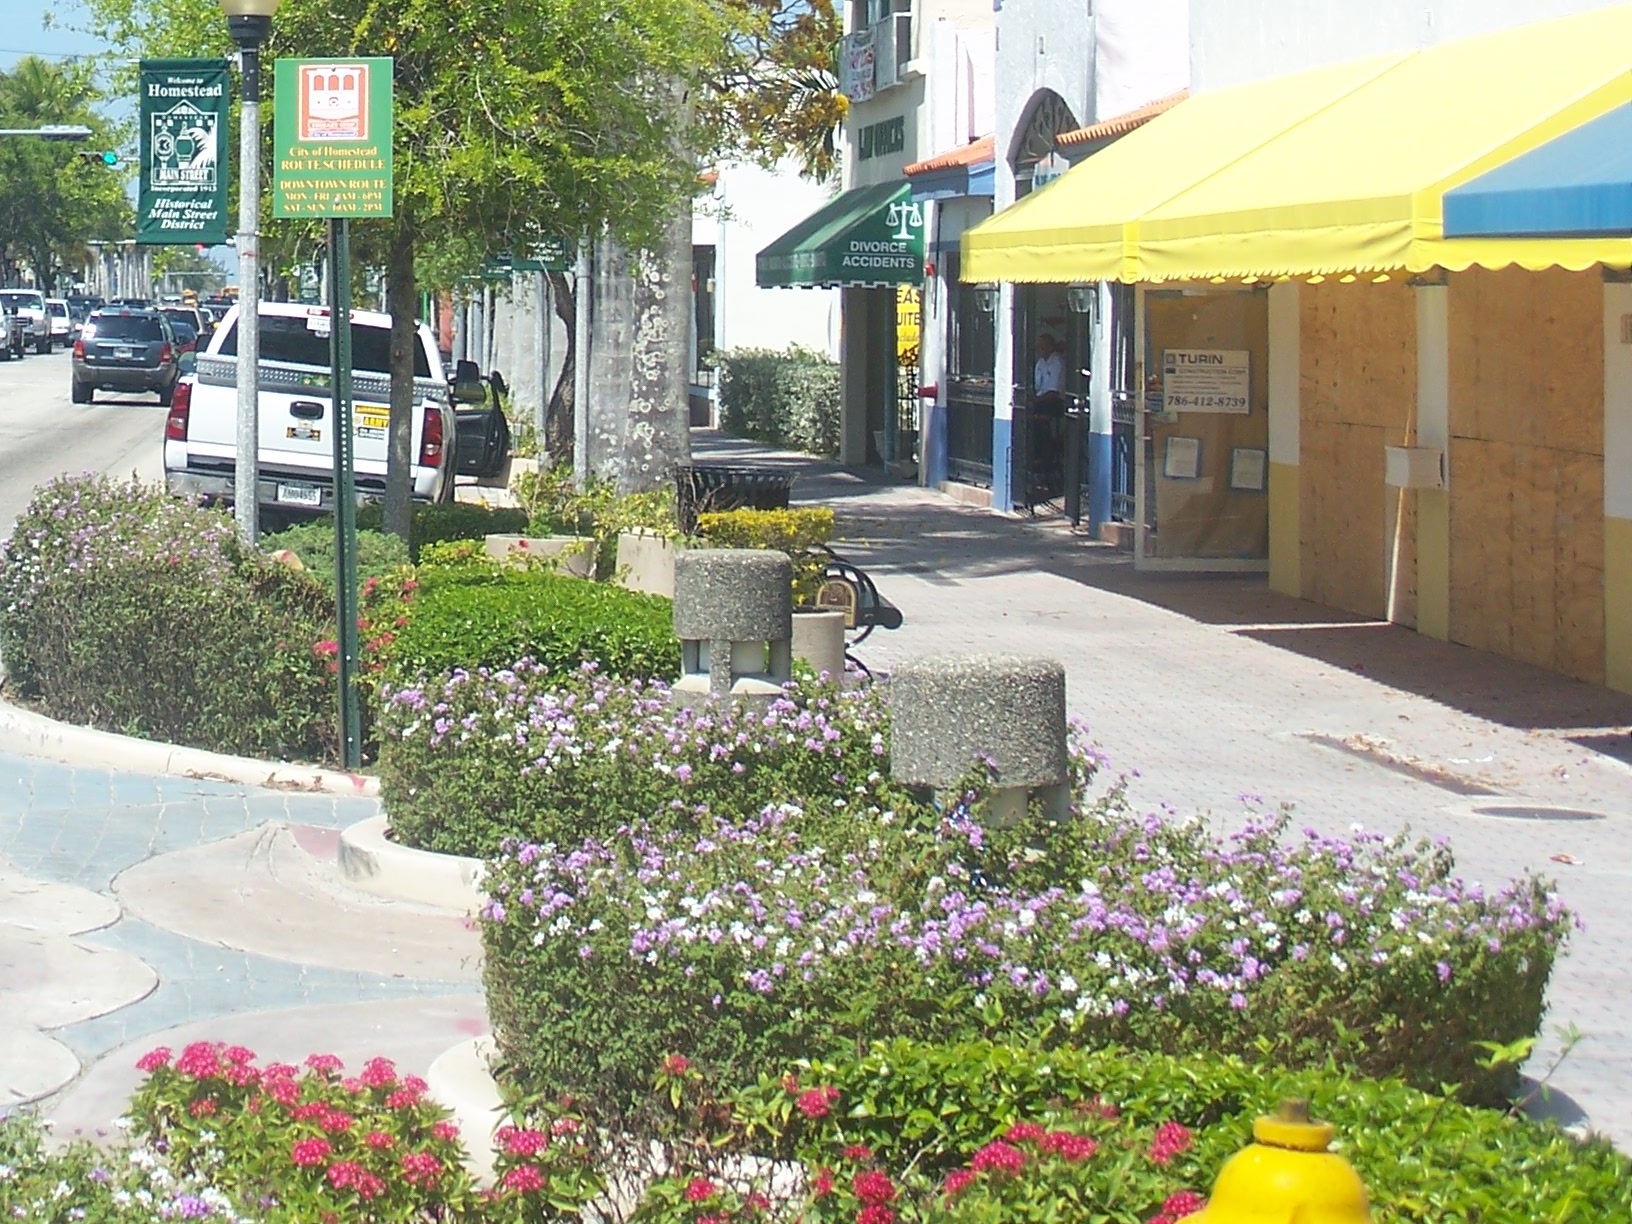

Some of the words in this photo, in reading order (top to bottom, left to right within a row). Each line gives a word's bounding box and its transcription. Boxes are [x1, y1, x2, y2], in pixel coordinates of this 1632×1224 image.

[148, 83, 223, 97] Homestead
[289, 147, 309, 159] City
[312, 146, 322, 157] of
[324, 146, 378, 157] Homestead
[281, 159, 321, 170] ROUTE
[322, 159, 385, 170] SCHEDULE
[159, 169, 179, 181] MAIN
[180, 169, 209, 180] STREET
[280, 180, 346, 190] DOWNTOWN
[349, 180, 386, 189] ROUTE
[285, 192, 307, 201] MON
[314, 192, 330, 201] FRI
[362, 192, 382, 201] 6PM
[154, 198, 213, 209] Historical
[284, 203, 300, 212] SAT
[307, 203, 326, 212] SUN
[363, 203, 382, 212] 2PM
[148, 209, 180, 219] Main
[182, 209, 218, 220] Street
[160, 219, 206, 230] District
[850, 241, 907, 253] DIVORCE
[842, 256, 915, 268] ACCIDENTS
[1178, 353, 1223, 365] TURIN
[1168, 395, 1247, 407] 786-412-8739
[364, 416, 388, 428] ARMY
